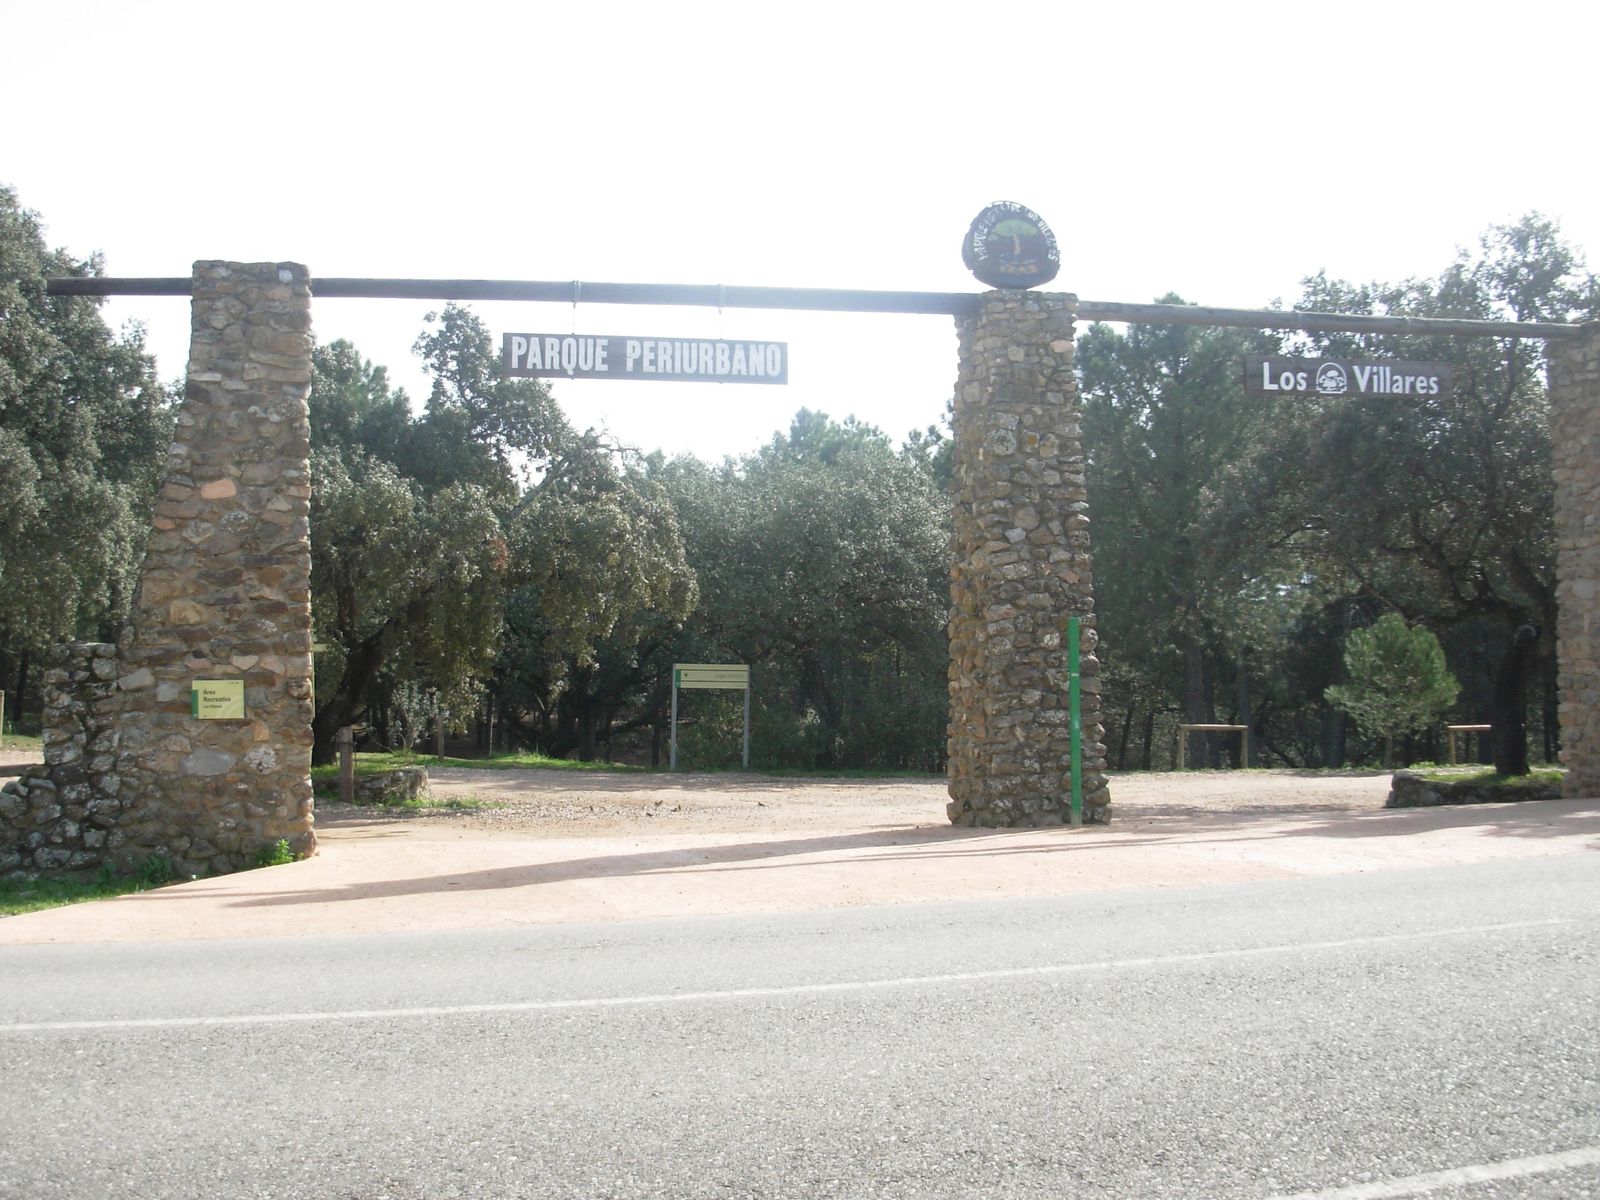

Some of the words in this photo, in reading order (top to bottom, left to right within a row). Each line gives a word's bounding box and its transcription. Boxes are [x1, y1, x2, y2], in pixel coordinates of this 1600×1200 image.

[511, 335, 609, 375] PARQUE
[626, 339, 782, 378] PERIURBANO
[1262, 361, 1308, 391] Los
[1352, 365, 1439, 395] Villares
